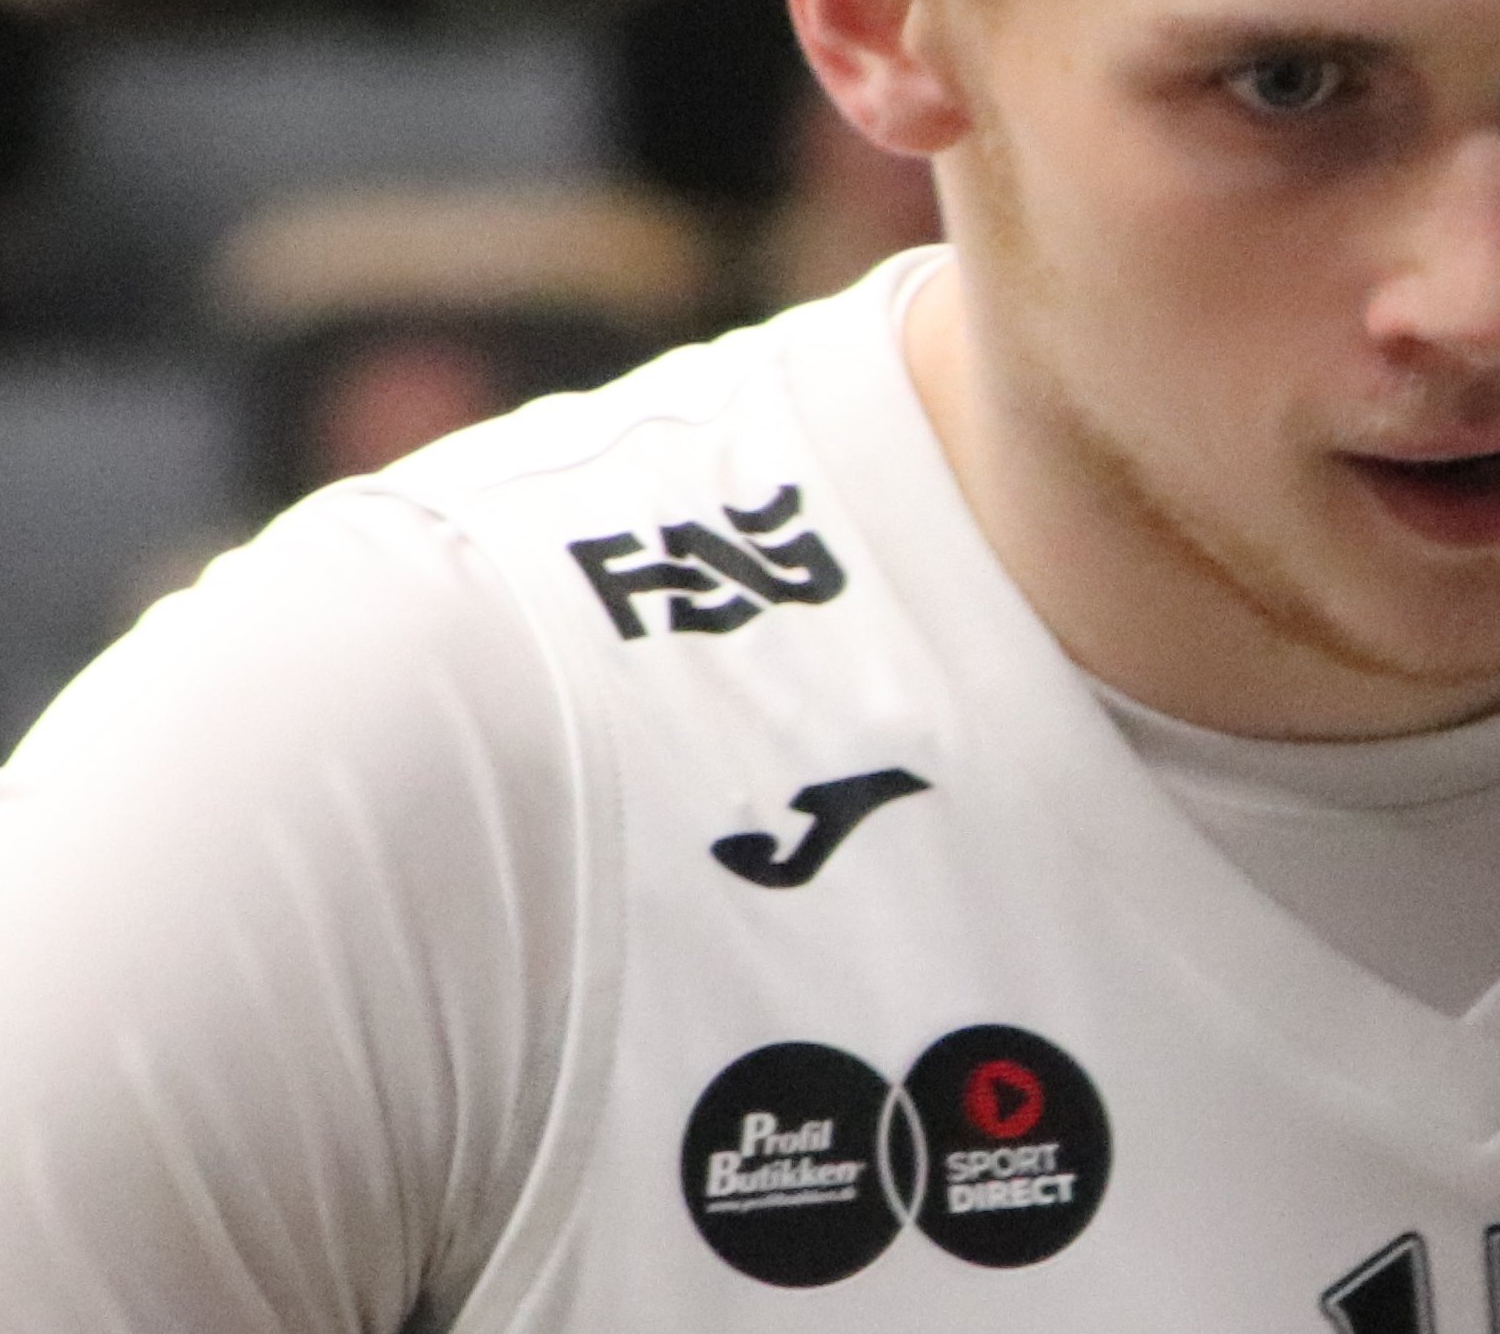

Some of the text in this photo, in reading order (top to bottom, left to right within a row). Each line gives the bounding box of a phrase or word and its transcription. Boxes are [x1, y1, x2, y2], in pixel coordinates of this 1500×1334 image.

[741, 1111, 833, 1158] Profil
[946, 1143, 1060, 1183] SPORT
[948, 1173, 1077, 1215] DIRECT
